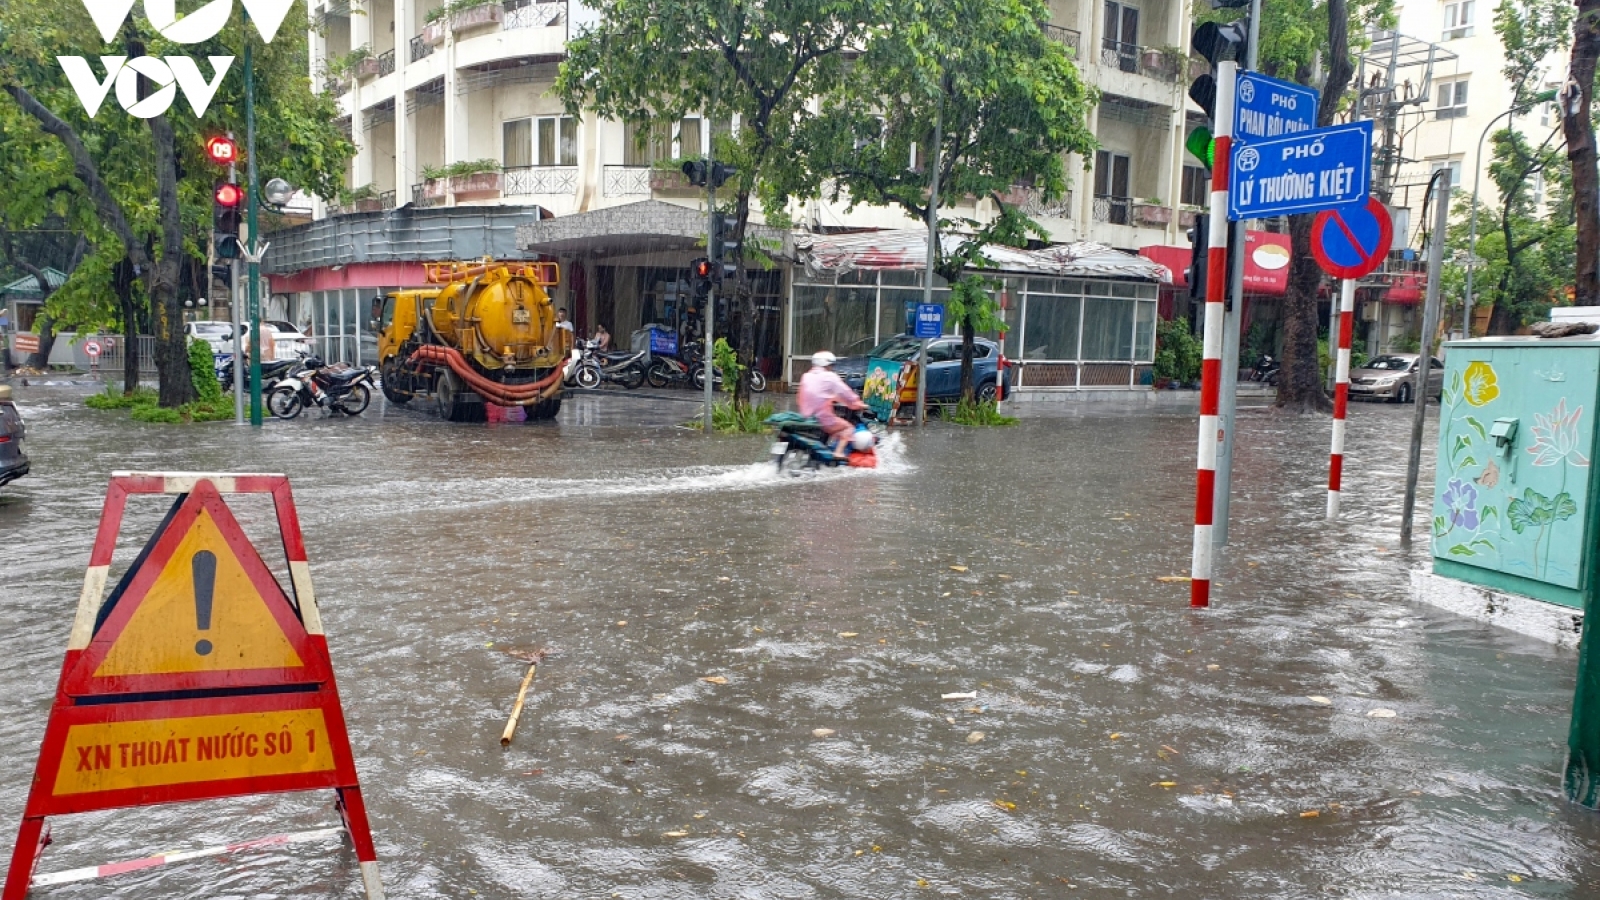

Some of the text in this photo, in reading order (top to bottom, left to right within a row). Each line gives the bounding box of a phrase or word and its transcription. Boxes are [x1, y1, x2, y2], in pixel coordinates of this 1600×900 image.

[1271, 93, 1298, 111] PHỐ
[1240, 108, 1266, 137] PHAN
[212, 142, 232, 158] 09
[1282, 136, 1326, 161] PHỐ
[1239, 161, 1355, 206] LÝ THƯỜNG KIỆT
[76, 719, 316, 773] XN THOÁT NƯỚC SỐ 1
